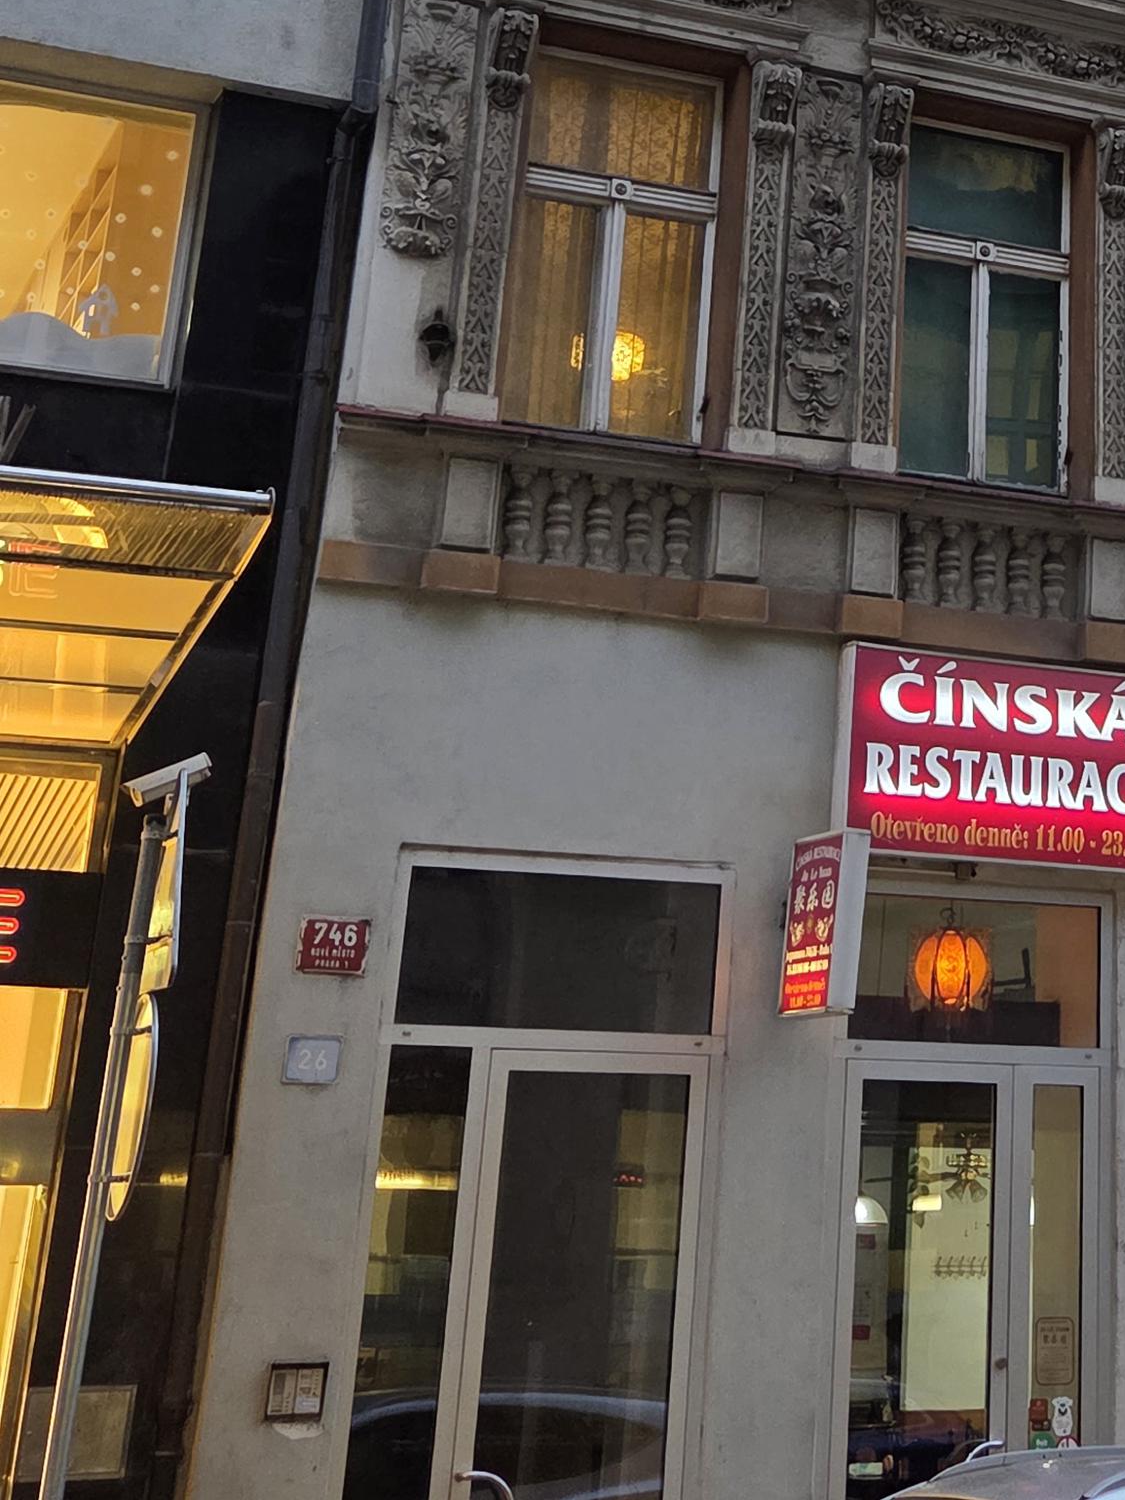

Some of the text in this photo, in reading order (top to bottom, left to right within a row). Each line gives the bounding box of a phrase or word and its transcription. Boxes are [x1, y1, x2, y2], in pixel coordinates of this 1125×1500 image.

[870, 811, 958, 844] Otevřeno
[963, 818, 1029, 849] denně:
[1035, 824, 1085, 854] 11.00
[313, 922, 358, 946] 746
[298, 1049, 327, 1071] 26
